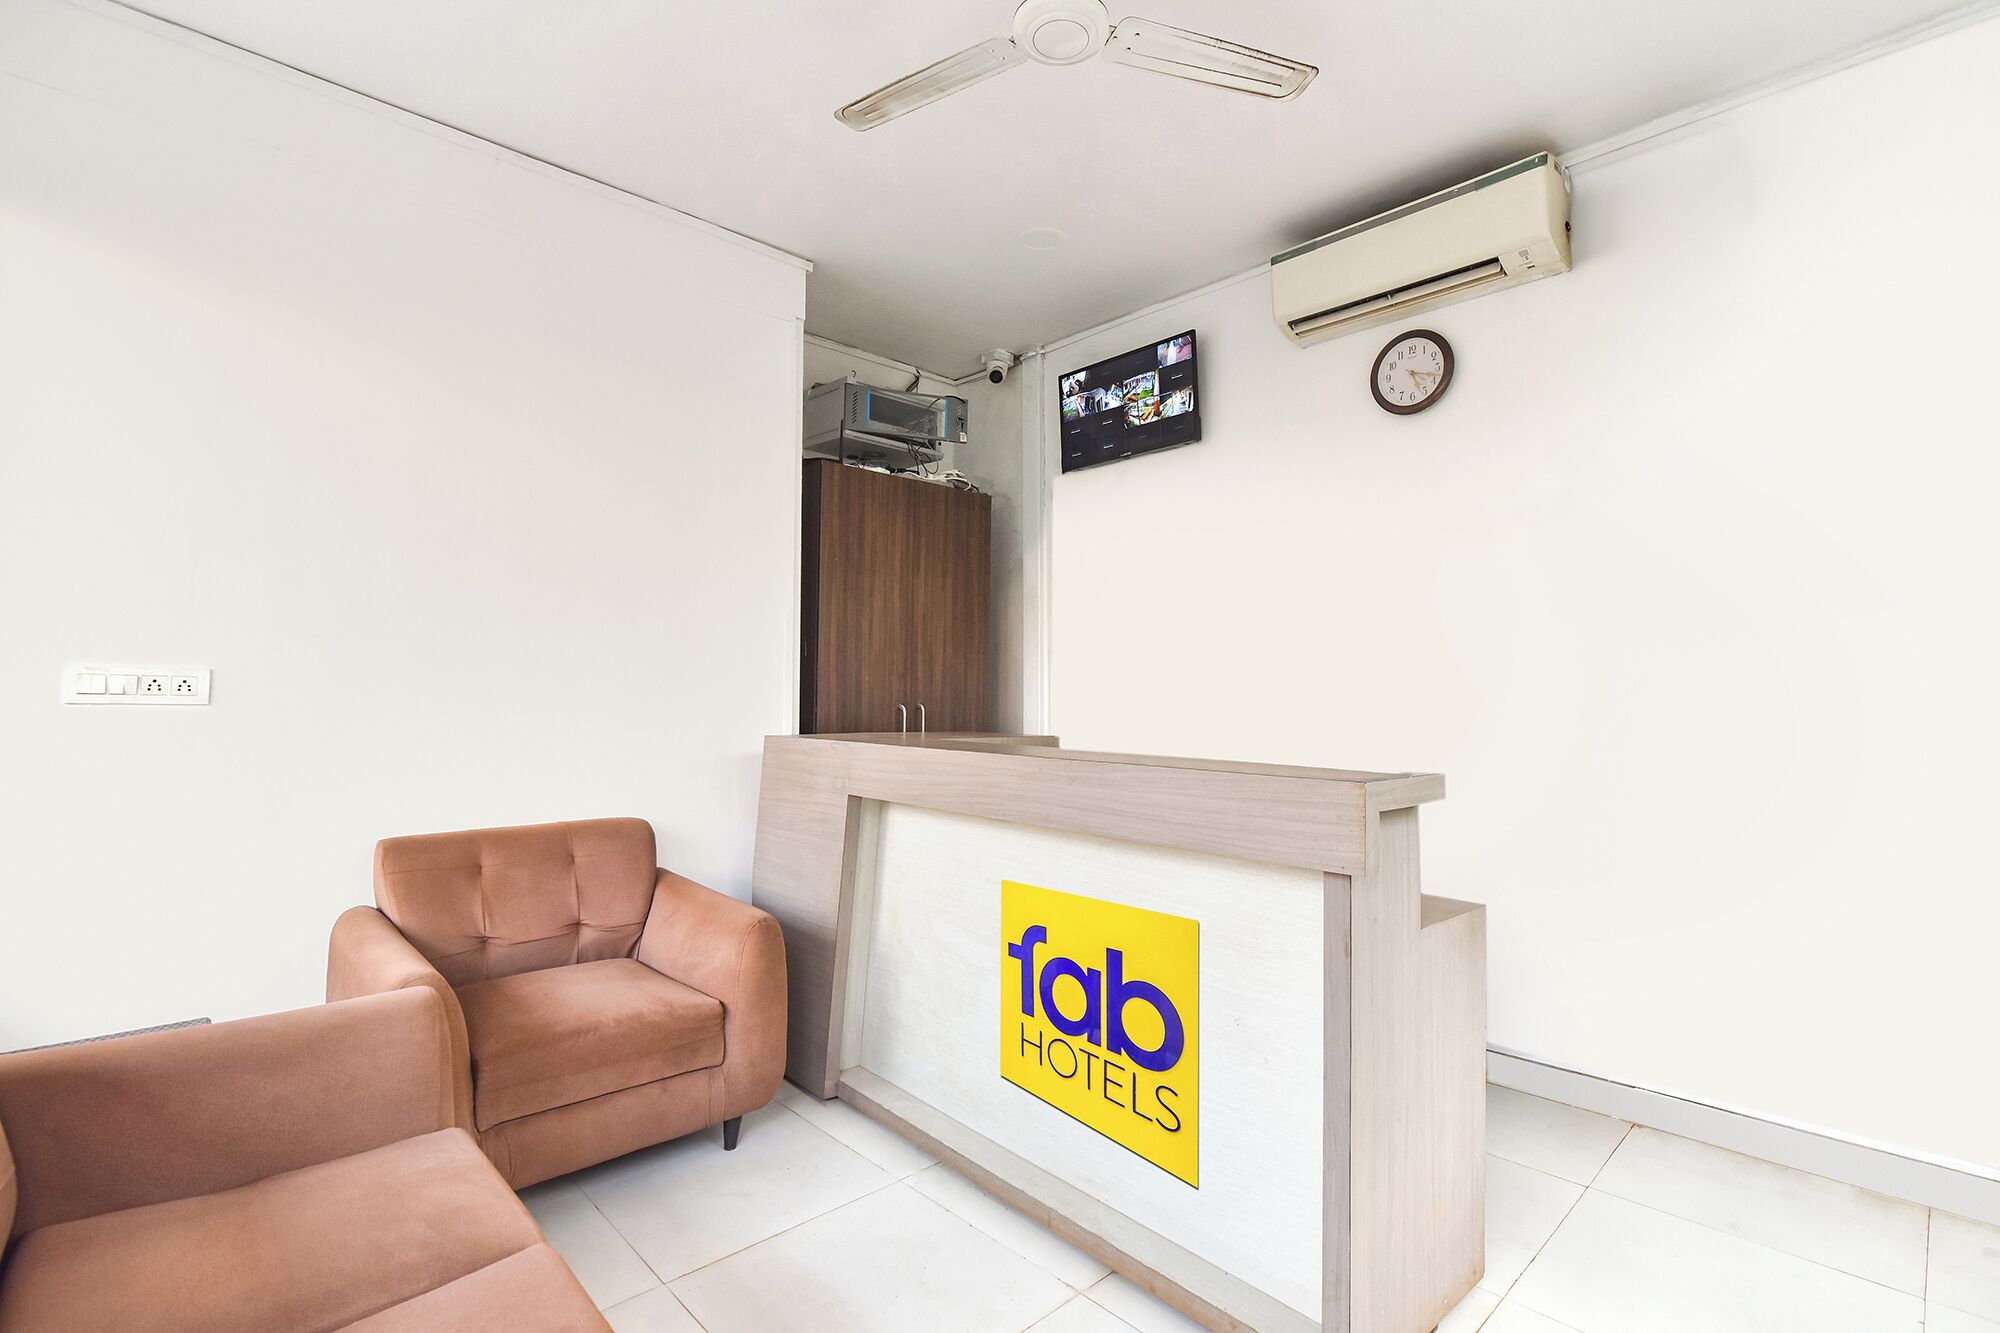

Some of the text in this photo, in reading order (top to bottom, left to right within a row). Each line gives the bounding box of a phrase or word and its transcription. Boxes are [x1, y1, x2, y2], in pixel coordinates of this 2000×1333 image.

[1408, 344, 1417, 355] 12
[1423, 345, 1426, 354] 1
[1398, 351, 1403, 360] 11
[1431, 351, 1437, 361] 2
[1389, 361, 1397, 371] 10
[1385, 374, 1391, 383] 9
[1389, 385, 1395, 394] 8
[1422, 386, 1428, 395] 5
[1399, 391, 1404, 401] 7
[1409, 392, 1416, 401] 6
[1008, 924, 1184, 1072] fab
[1021, 1022, 1182, 1133] HOTELS
